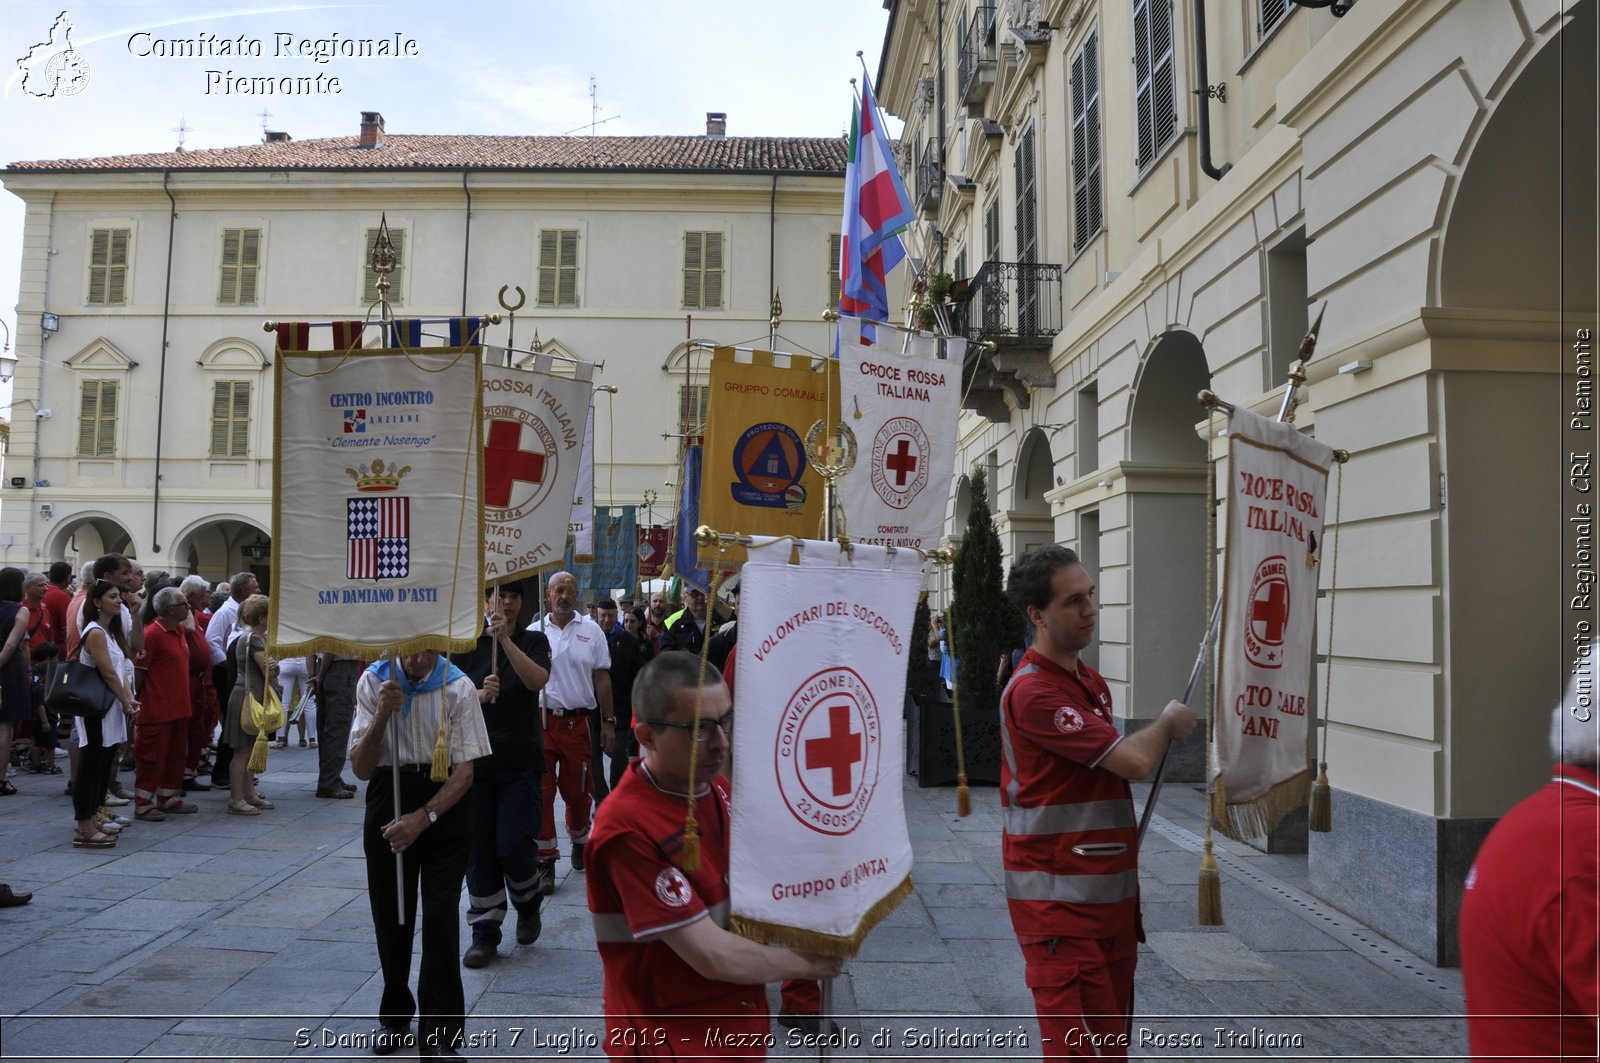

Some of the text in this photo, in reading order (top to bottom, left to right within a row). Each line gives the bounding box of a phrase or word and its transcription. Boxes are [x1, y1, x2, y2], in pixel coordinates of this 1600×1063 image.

[860, 361, 946, 387] CROCE ROSSA
[330, 390, 433, 407] CENTRO INCONTRO
[724, 382, 826, 402] GRUPPO COMUNALE
[877, 382, 930, 403] ITALIANA
[369, 415, 420, 424] ANZIANI
[536, 388, 577, 450] ITALIANA
[519, 412, 530, 421] DI
[531, 418, 557, 458] GINEVRA
[485, 523, 522, 539] ITATO
[505, 542, 553, 573] D'ASTI
[1261, 563, 1287, 578] GINE
[318, 587, 438, 604] SAN DAMIANO D'ASTI
[753, 601, 903, 662] VOLONTARI DEL SOCCORSO
[781, 675, 845, 757] CONVENZIONE
[796, 798, 812, 816] 22
[771, 877, 835, 901] Gruppo
